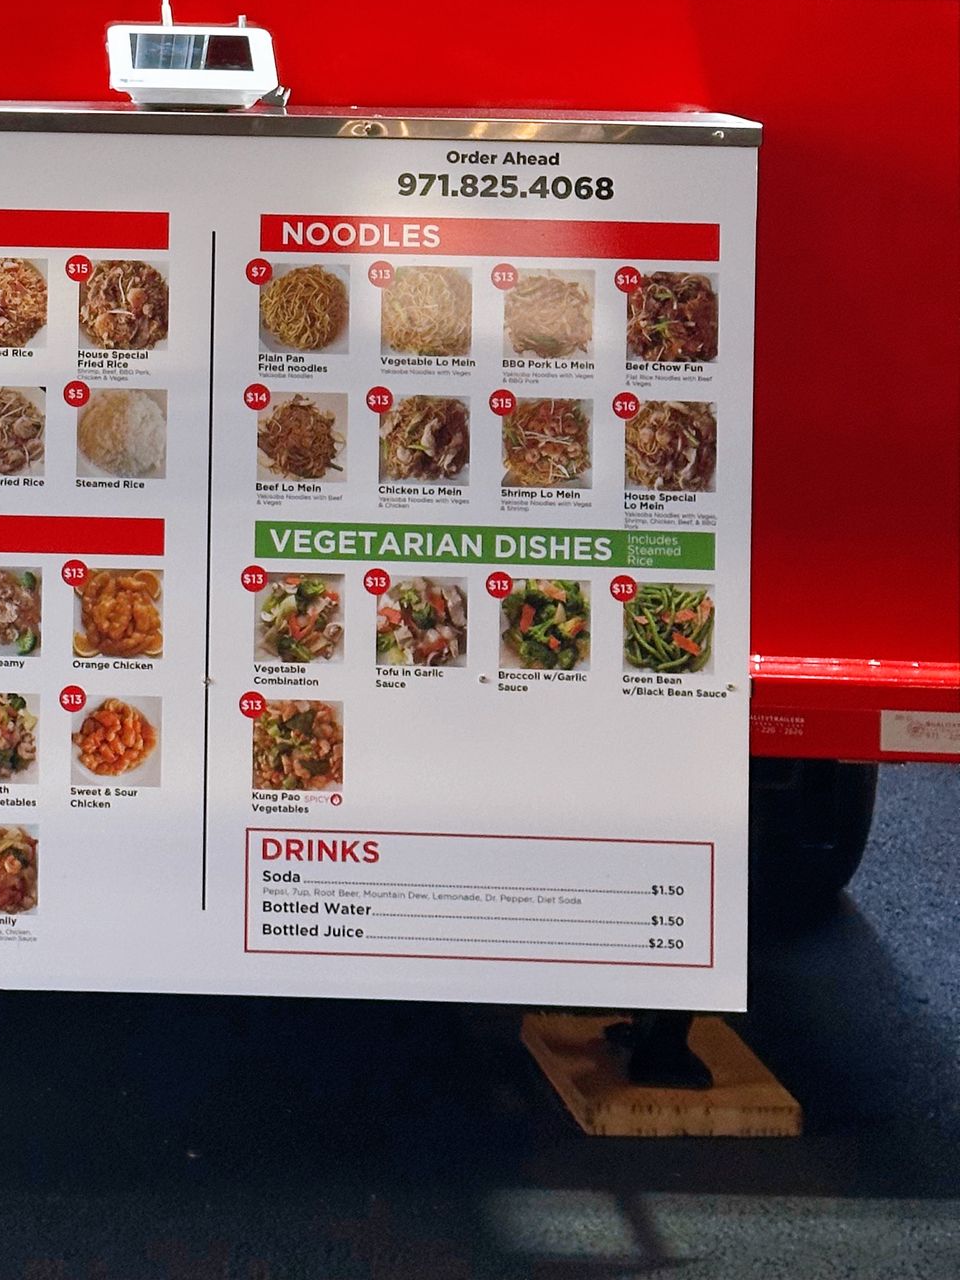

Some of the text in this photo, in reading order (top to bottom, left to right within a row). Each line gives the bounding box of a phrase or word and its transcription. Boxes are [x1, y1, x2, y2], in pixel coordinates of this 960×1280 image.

[447, 151, 559, 166] Order Ahead
[398, 173, 614, 200] 971.825.4068
[281, 221, 440, 249] NOODLES
[251, 266, 266, 278] $7
[12, 347, 33, 357] Rice
[78, 351, 148, 361] House Special
[78, 359, 128, 368] Fried Rice
[381, 357, 432, 366] Vegetable
[436, 356, 448, 366] Lo
[652, 362, 683, 371] Chow
[683, 362, 704, 372] Fun
[68, 388, 84, 400] $5
[615, 400, 636, 411] $16
[76, 480, 145, 488] Steamed Rice
[256, 483, 279, 491] Beef
[298, 484, 321, 492] Mein
[269, 528, 612, 561] VEGETARIAN DISHES
[628, 534, 678, 546] Includes
[628, 545, 681, 556] Steamed
[628, 556, 653, 567] Rice
[243, 573, 264, 585] $13
[73, 660, 153, 670] Orange Chicken
[254, 665, 306, 674] Vegetable
[254, 677, 319, 686] Combination
[623, 674, 684, 684] Green Bean
[623, 685, 728, 698] w/Black Bean Sauce
[262, 838, 379, 863] DRINKS
[263, 870, 684, 896] Soda $1.50
[314, 888, 335, 897] Root
[364, 889, 406, 900] Mountain
[537, 895, 555, 905] Diet
[558, 896, 582, 905] Soda
[263, 901, 684, 926] Bottled Water $1.50
[263, 924, 684, 949] Bottled Juice $2.50
